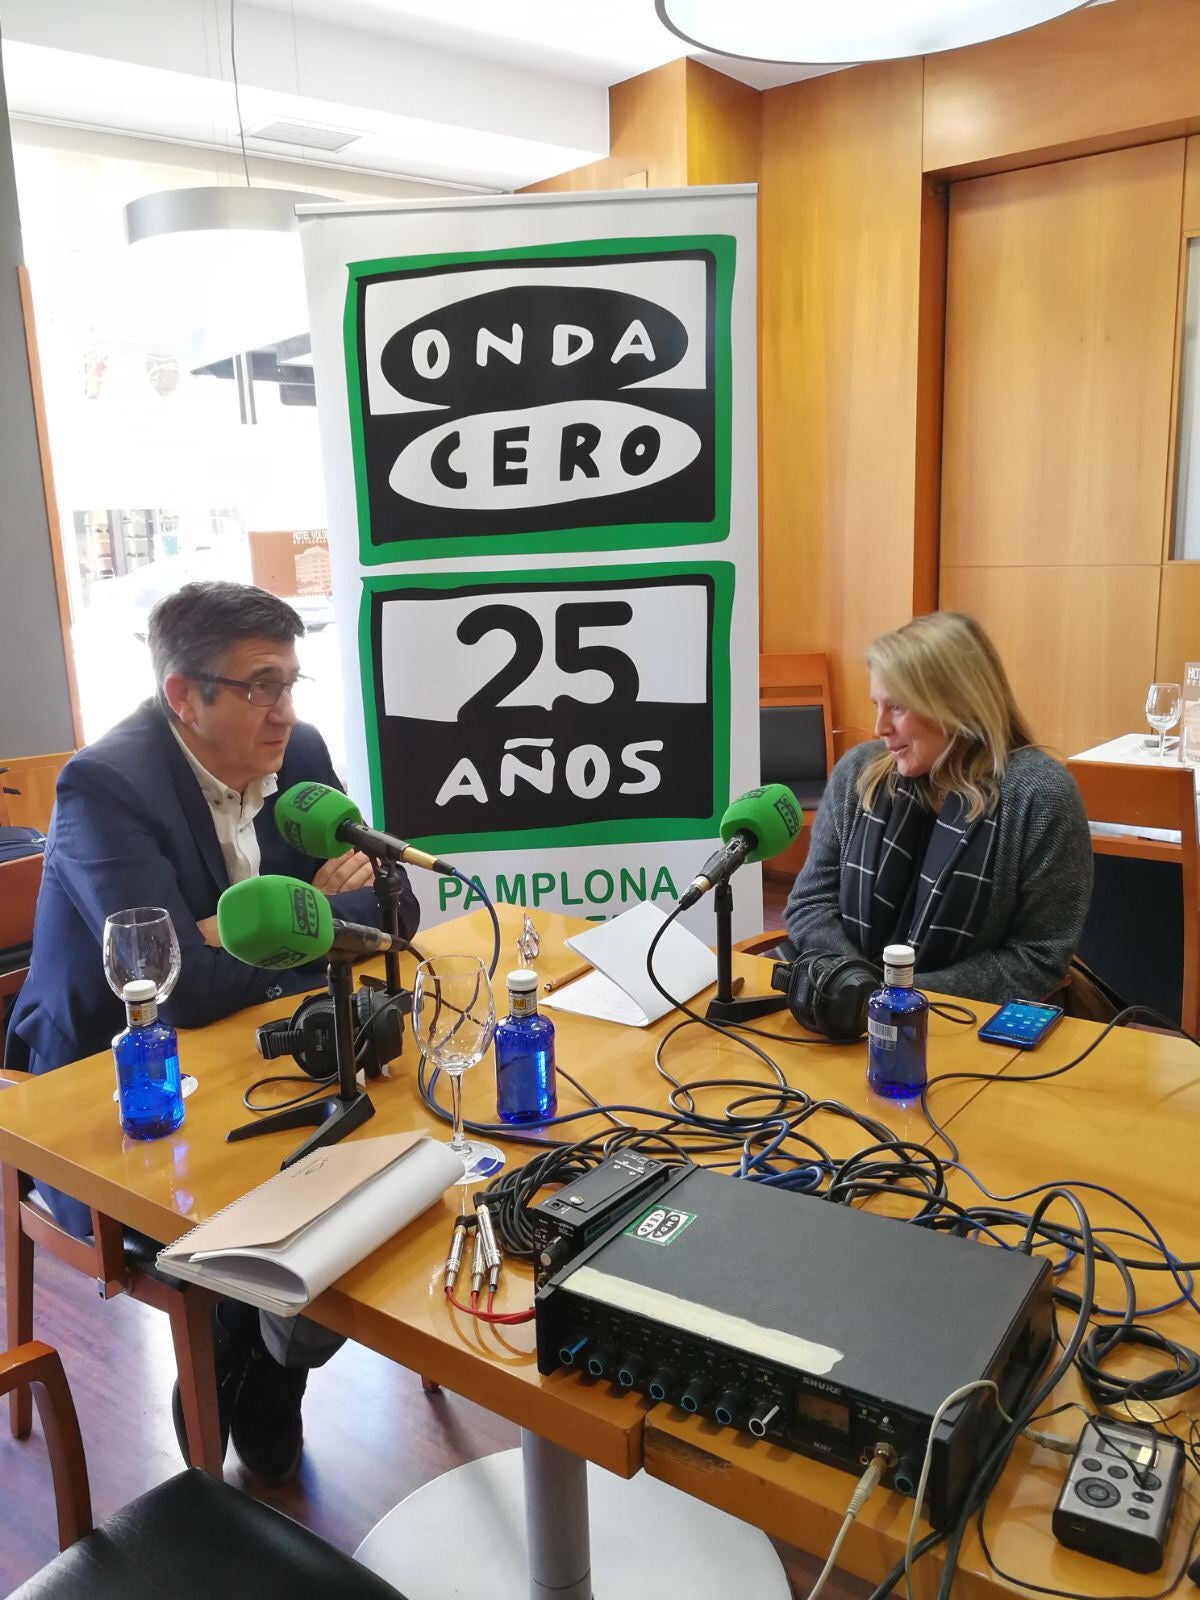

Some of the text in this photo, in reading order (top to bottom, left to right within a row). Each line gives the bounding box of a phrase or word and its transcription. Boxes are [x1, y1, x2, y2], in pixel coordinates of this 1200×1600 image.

[411, 319, 656, 379] ONDA
[430, 422, 661, 489] CERO
[456, 600, 640, 723] 25
[435, 737, 664, 807] AÑOS
[438, 866, 680, 911] PAMPLONA
[639, 1213, 664, 1233] CERO
[653, 1215, 679, 1237] ONDA
[802, 1376, 842, 1396] SHURE
